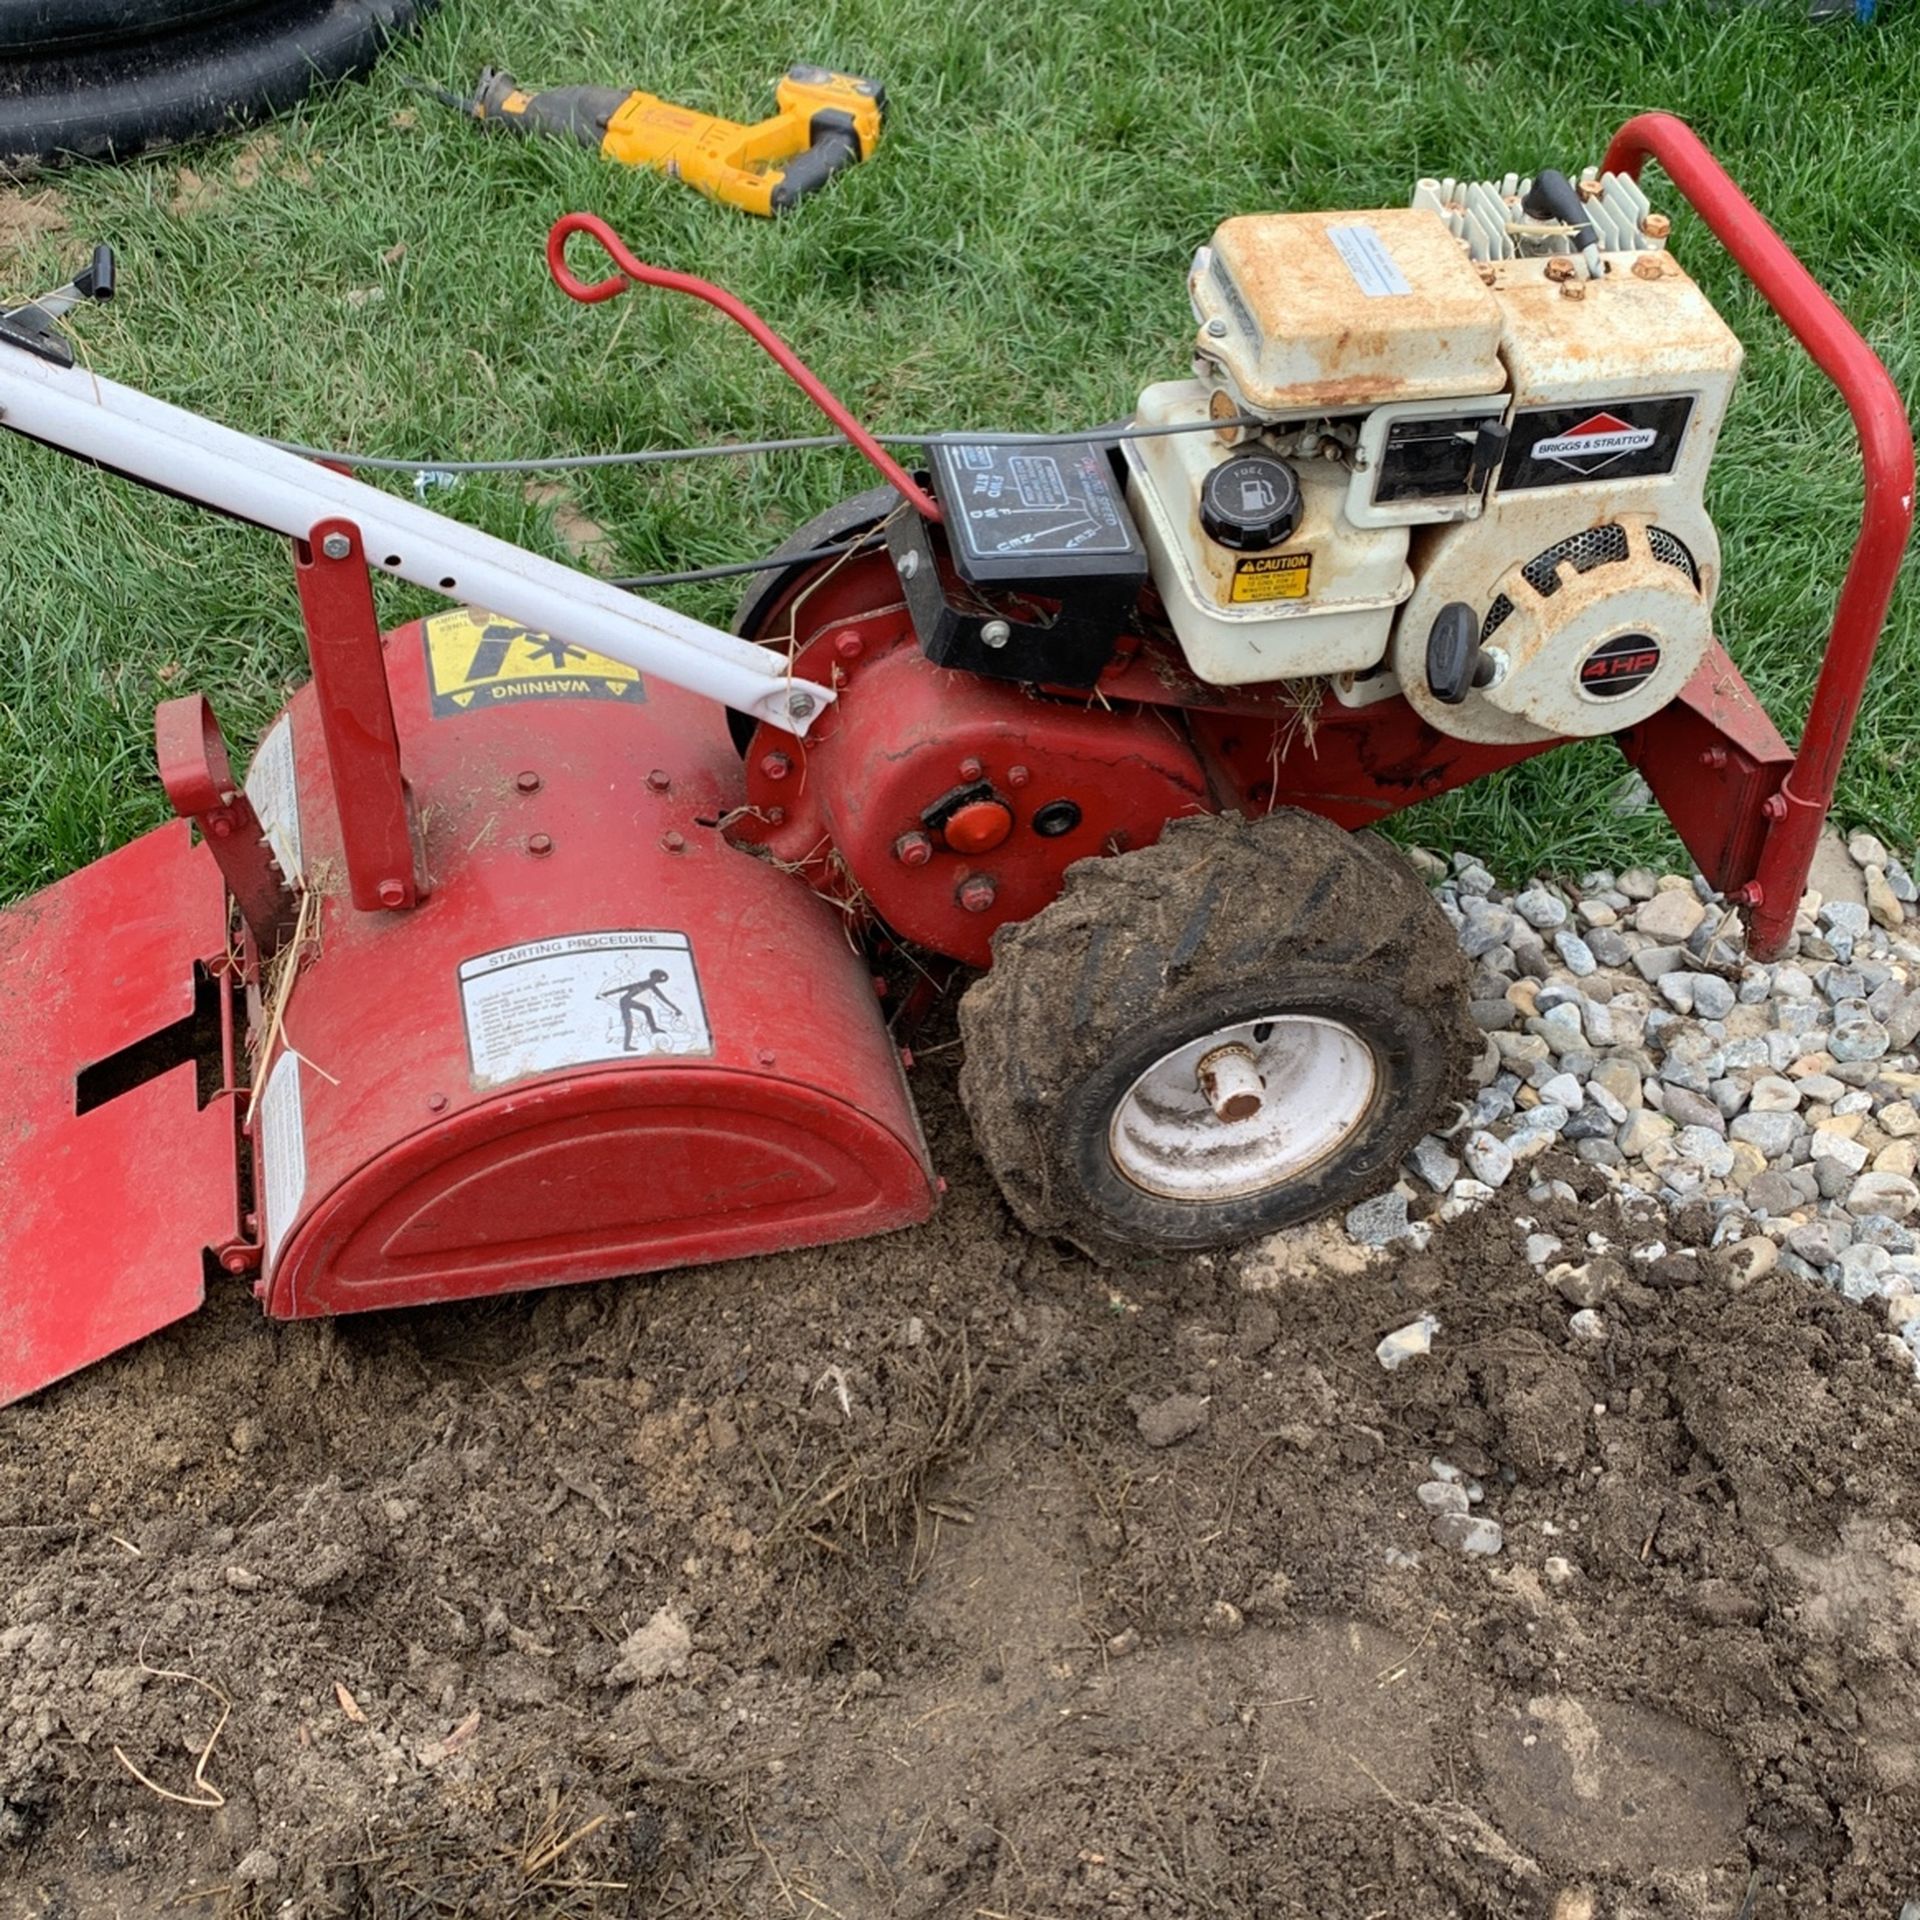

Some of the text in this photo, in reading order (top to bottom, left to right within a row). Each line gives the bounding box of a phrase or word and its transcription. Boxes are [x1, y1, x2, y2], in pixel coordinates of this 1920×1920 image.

[1538, 435, 1650, 454] BRIGGS & STRATTON
[1233, 466, 1264, 478] FUEL
[986, 475, 1004, 497] FWD
[970, 508, 1012, 518] FWD
[1097, 496, 1117, 526] SPEED
[997, 533, 1035, 551] NEU
[1066, 529, 1096, 548] REV
[1256, 556, 1309, 571] CAUTION
[491, 680, 591, 698] WARNING
[489, 935, 658, 967] STARTING PROCEDURE
